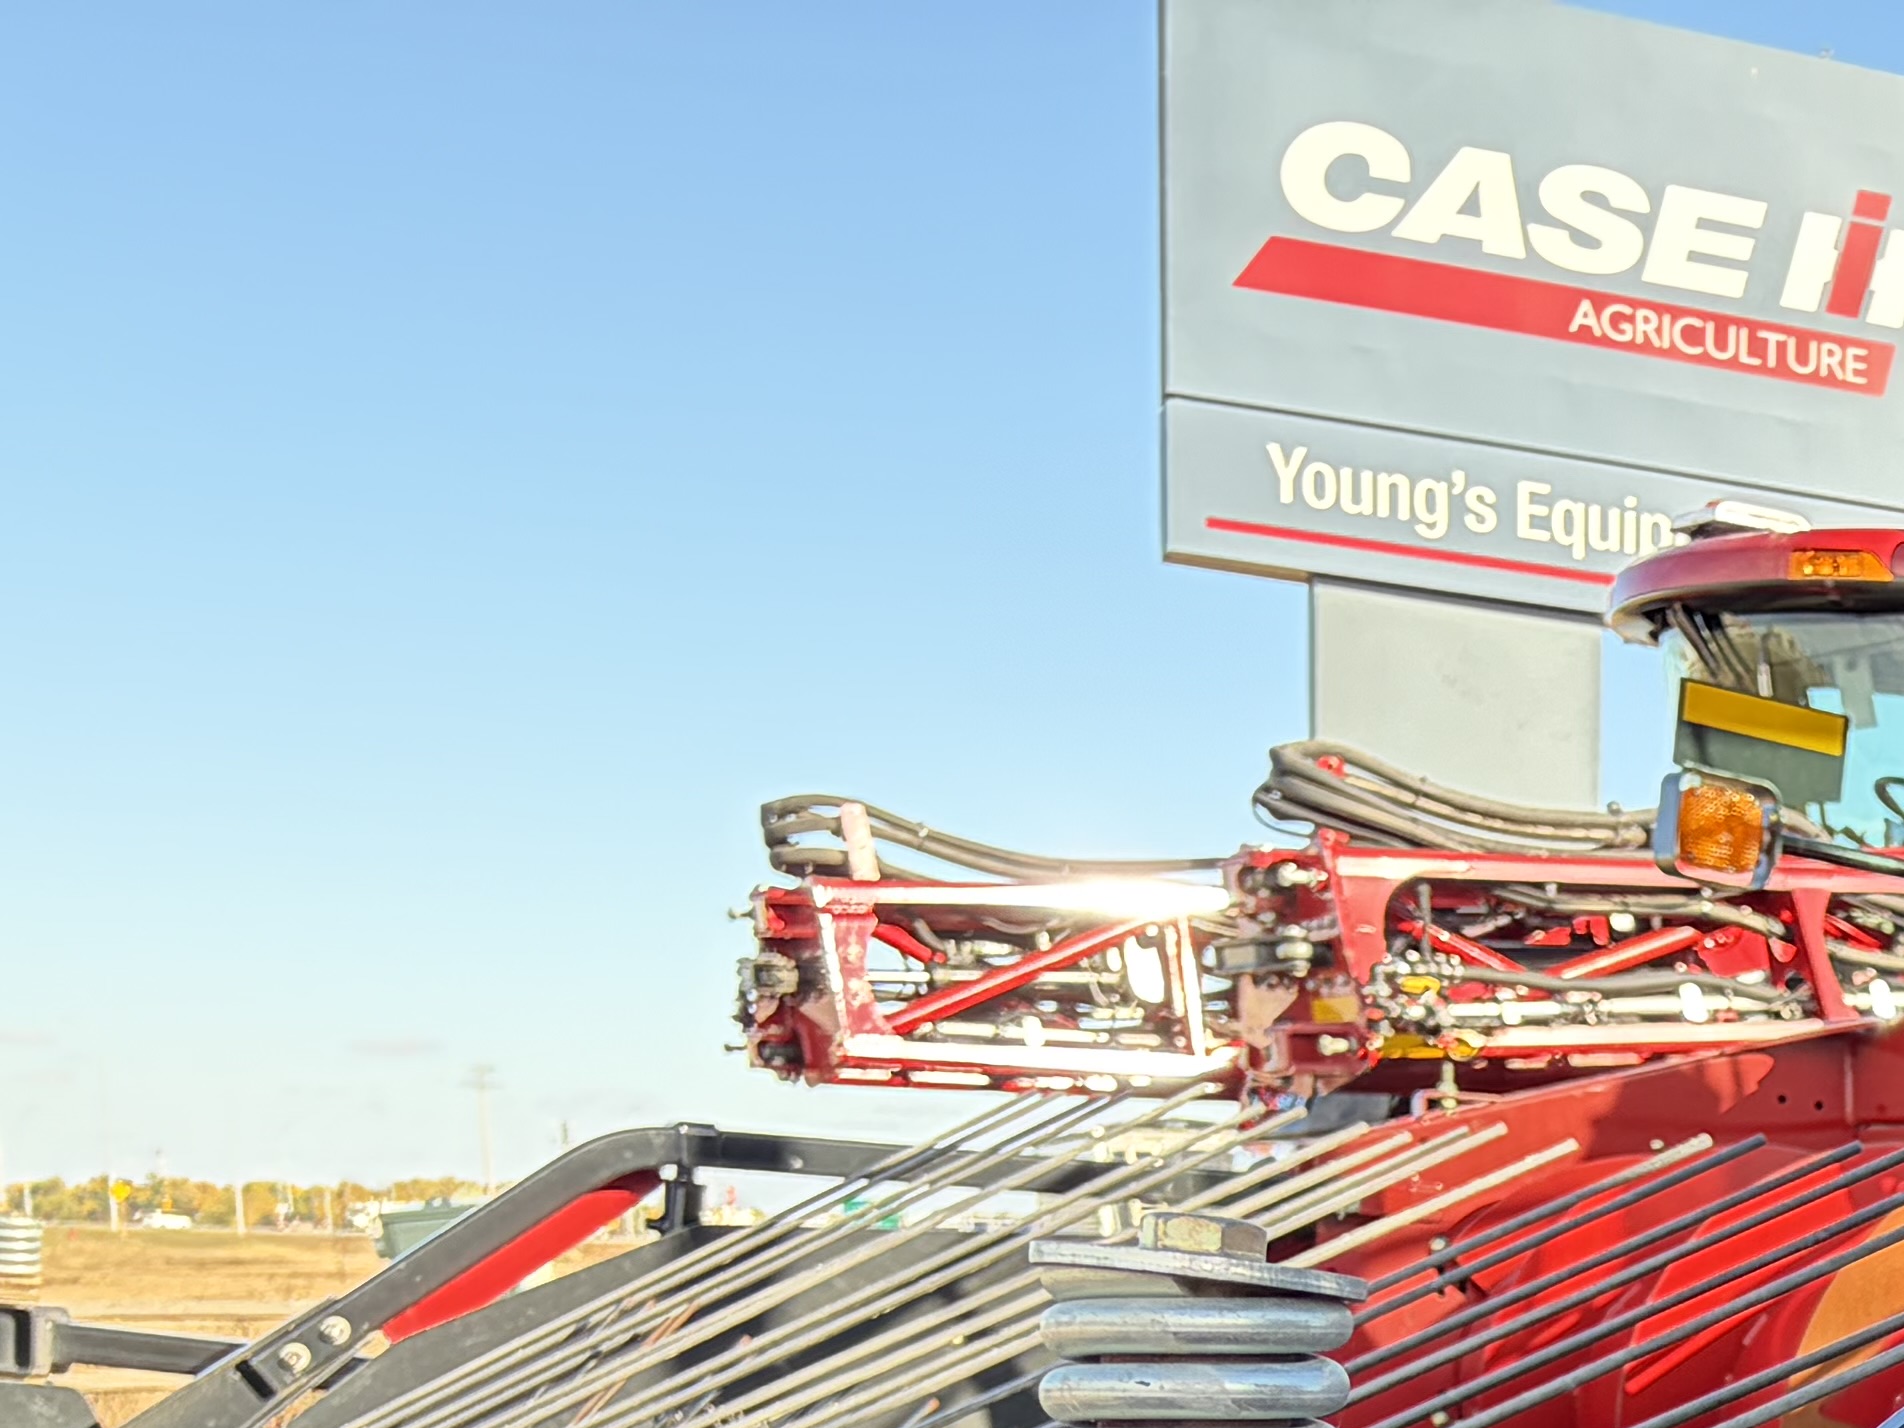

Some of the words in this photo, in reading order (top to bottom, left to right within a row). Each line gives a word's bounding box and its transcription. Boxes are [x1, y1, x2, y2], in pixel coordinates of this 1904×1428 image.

[1278, 120, 1768, 300] CASE
[1567, 297, 1869, 386] AGRICULTURE
[1264, 440, 1498, 537] Young's
[1515, 481, 1692, 561] Equip
